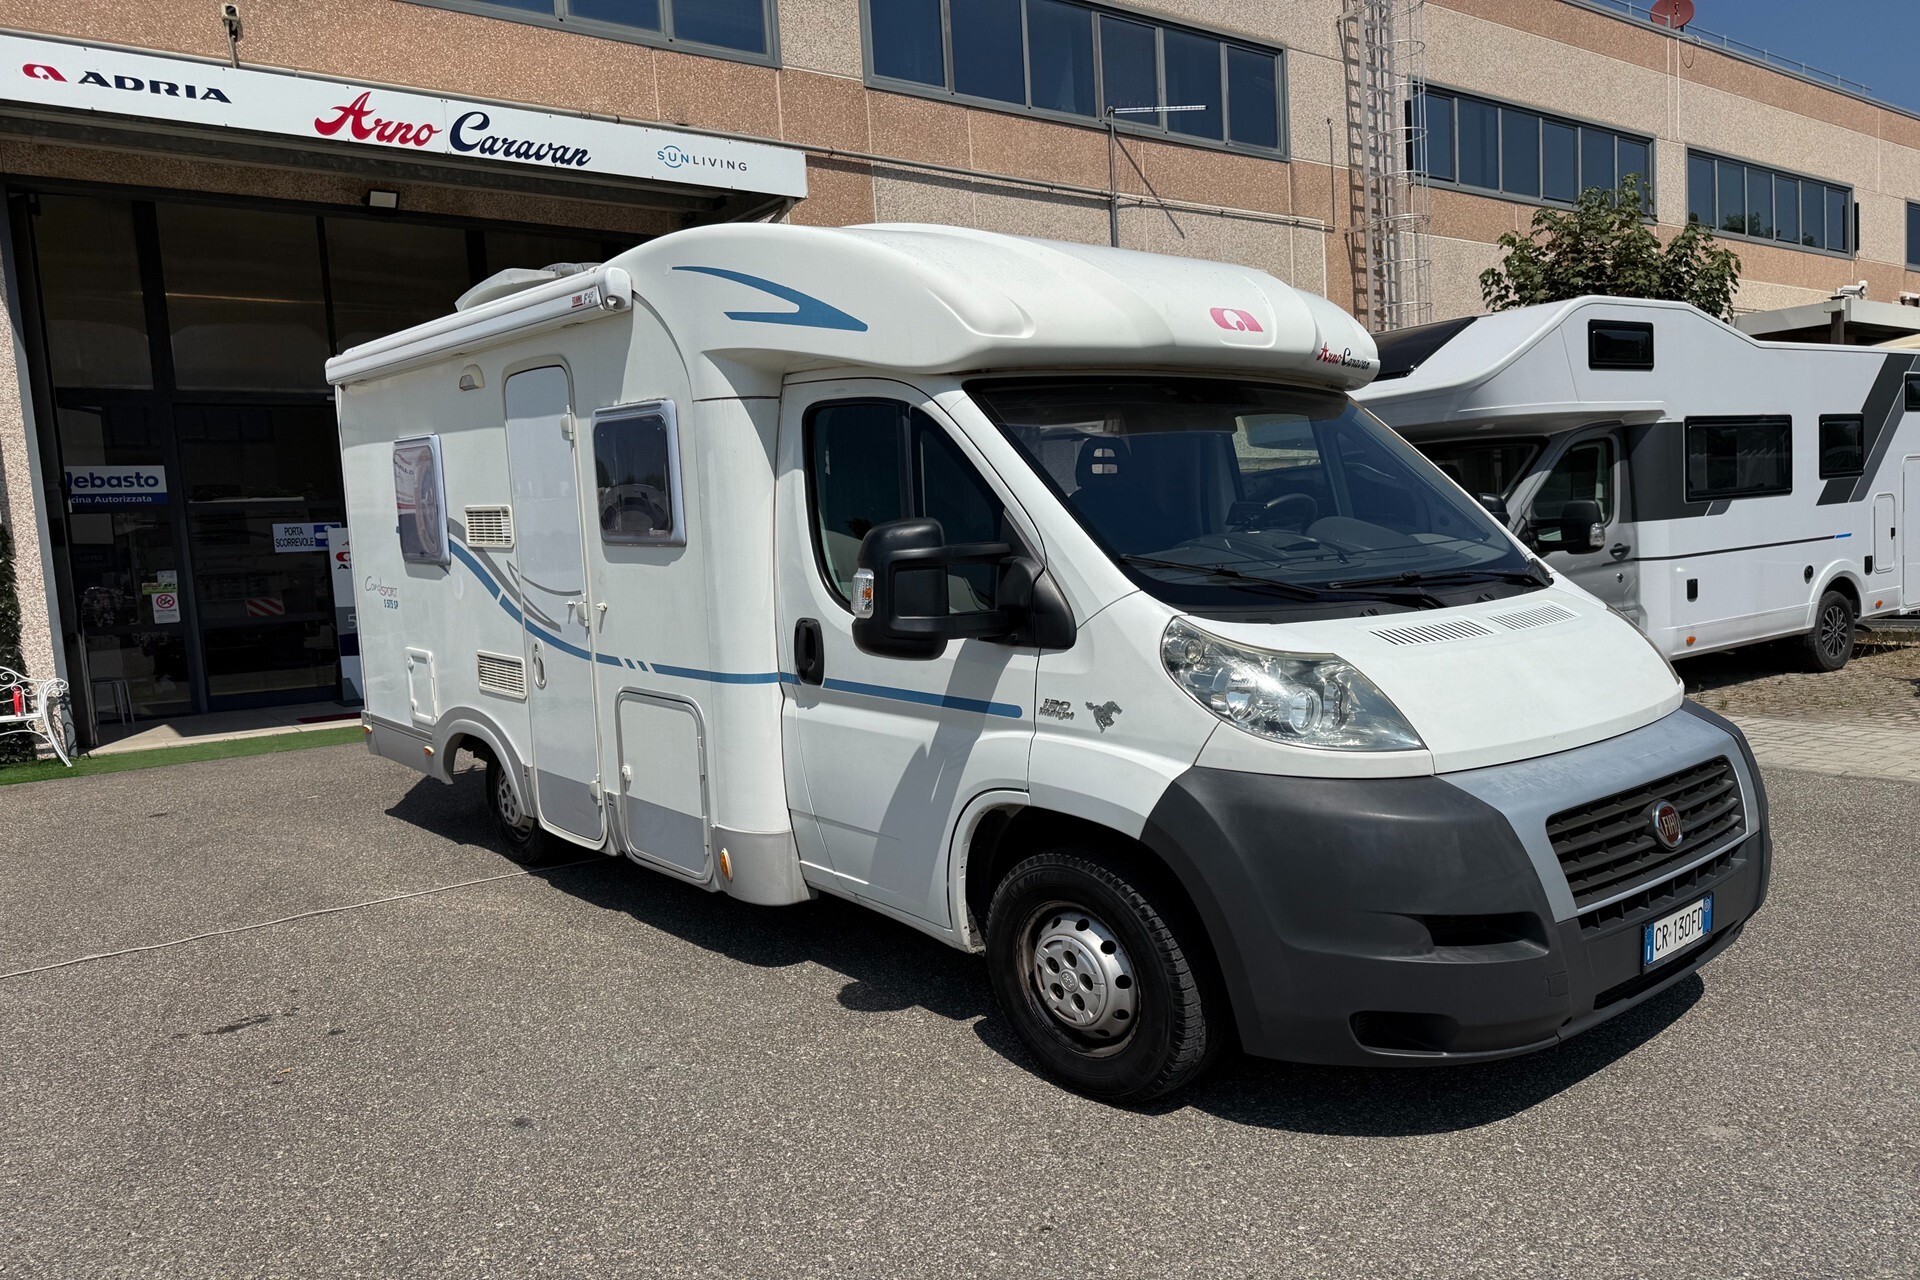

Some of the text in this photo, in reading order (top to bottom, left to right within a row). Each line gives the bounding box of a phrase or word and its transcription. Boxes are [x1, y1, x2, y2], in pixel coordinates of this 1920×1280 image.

[78, 71, 233, 104] ADRIA
[314, 91, 591, 167] Arno Caravan
[657, 148, 747, 171] SUNLIVING
[1316, 341, 1370, 370] Arno Caravan
[65, 472, 159, 489] ebasto
[94, 495, 152, 503] Autorizzata
[275, 537, 315, 547] SCORREVOLE
[284, 527, 304, 536] PORTA
[1661, 813, 1679, 837] FIAT
[1655, 906, 1703, 952] CR 130FD
